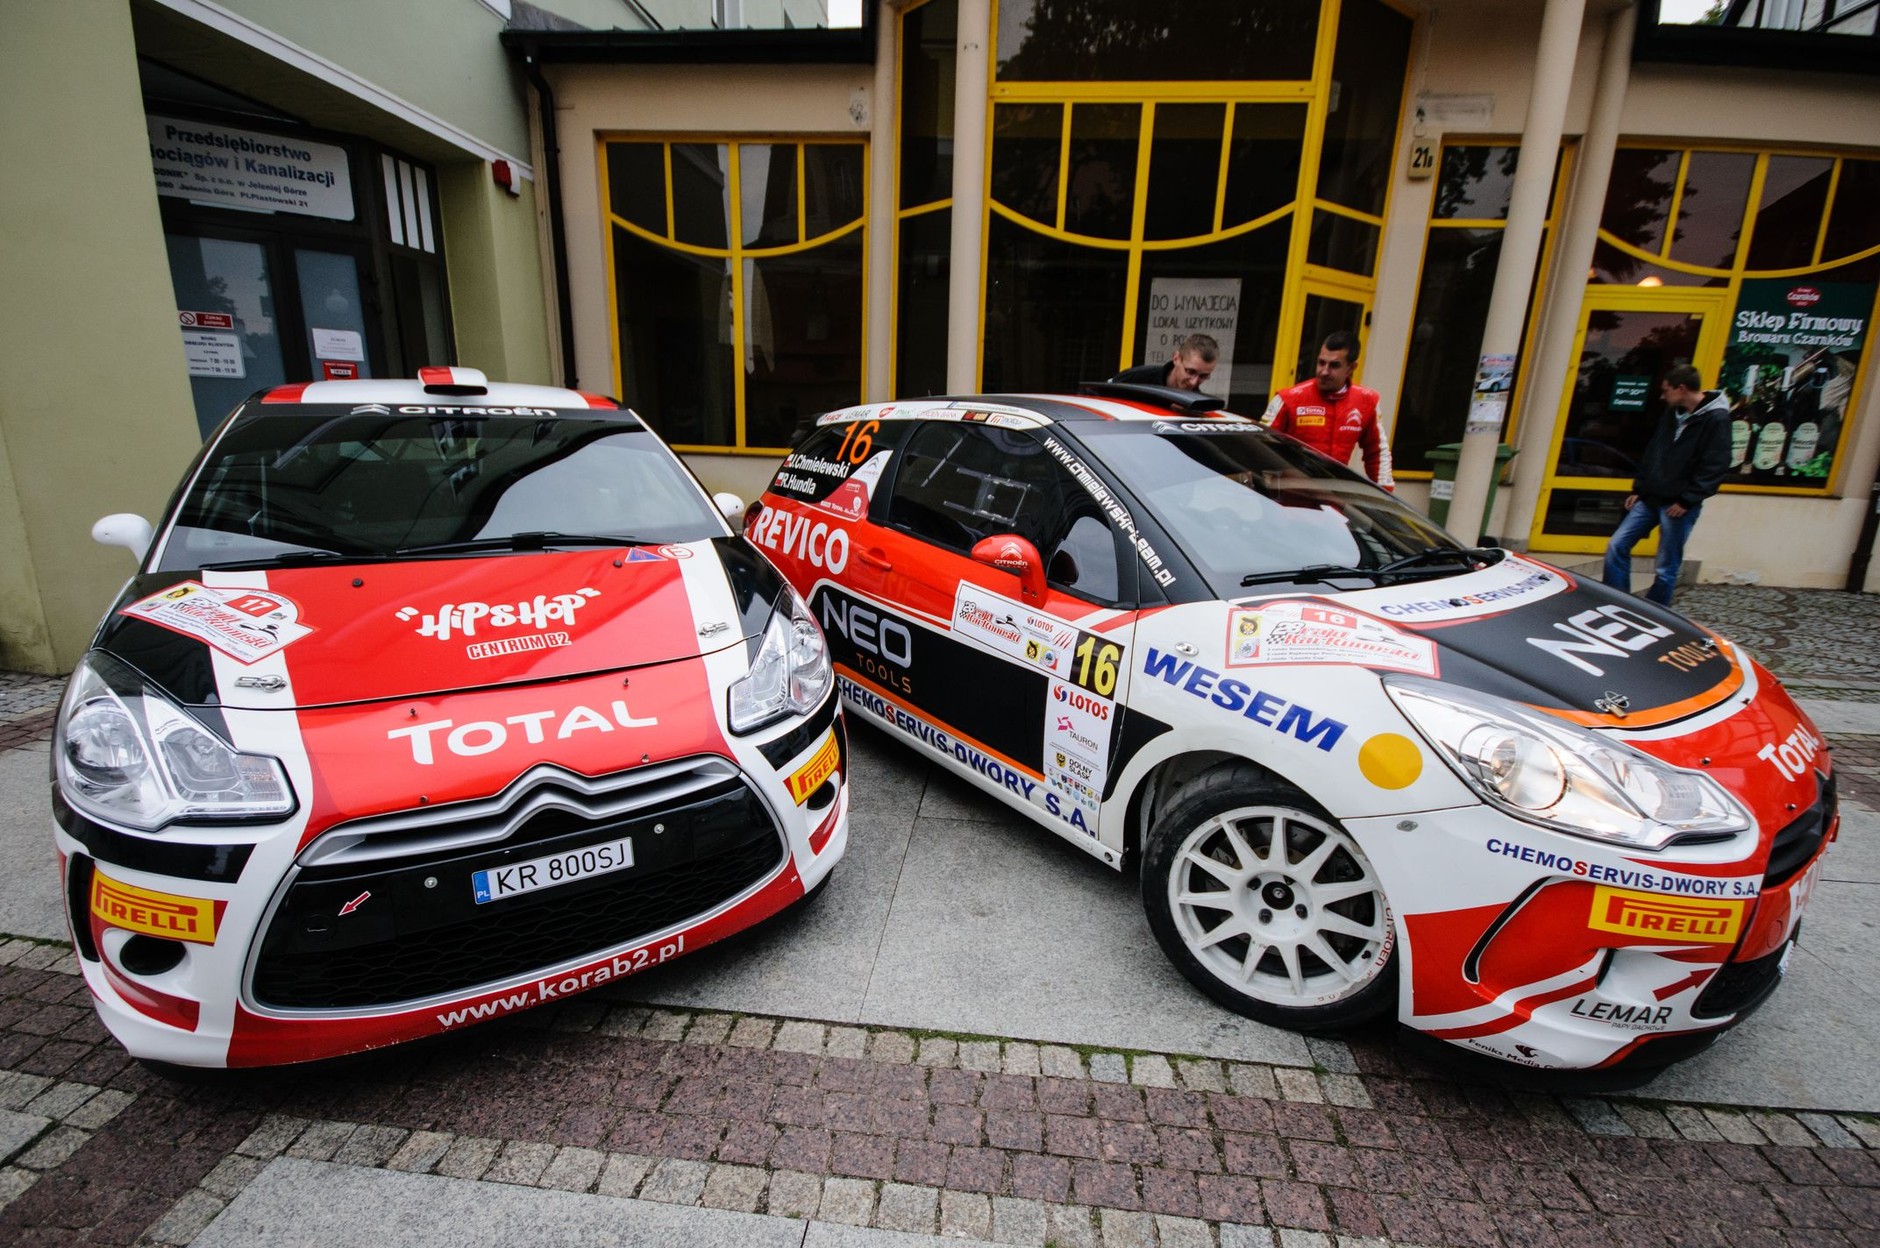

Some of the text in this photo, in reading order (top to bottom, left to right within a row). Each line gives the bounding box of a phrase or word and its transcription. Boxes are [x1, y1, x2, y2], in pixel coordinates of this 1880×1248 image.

[165, 125, 311, 162] Przedsiębiorstwo
[235, 156, 240, 170] i
[245, 159, 335, 188] Kanalizacji
[247, 181, 281, 193] Jeleniej
[283, 186, 307, 196] Górze
[1151, 294, 1169, 310] DO
[1153, 316, 1181, 329] LOKAL
[1735, 310, 1863, 335] Sklep Firmowy
[1737, 330, 1855, 347] Browaru Czarnków
[835, 420, 880, 465] 16
[789, 454, 850, 479] J.Chmielewski
[781, 472, 817, 495] R.Hundla
[752, 506, 850, 575] REVICO
[240, 598, 274, 611] 17
[1313, 611, 1346, 625] 16
[822, 591, 912, 669] NEO
[1034, 616, 1054, 633] LOTOS
[1526, 604, 1675, 677] NEO
[466, 631, 572, 660] CENTRUM B2
[855, 653, 912, 694] TOOLS
[1076, 635, 1119, 696] 16
[1069, 691, 1109, 721] LOTOS
[1143, 647, 1349, 753] WESEM
[387, 700, 659, 765] TOTAL
[1068, 730, 1099, 751] TAURON
[1756, 722, 1820, 783] TOTAL
[1045, 793, 1096, 838] S.A.
[497, 843, 625, 895] KR 800SJ
[1486, 838, 1728, 896] CHEMOSERVIS-DWORY
[1733, 881, 1760, 896] S.A.
[96, 881, 198, 933] PIRELLI
[477, 890, 490, 899] PL
[1605, 895, 1732, 935] PIRELLI
[437, 935, 684, 1028] www.korab2.pl
[1571, 999, 1673, 1024] LEMAR
[1468, 1038, 1540, 1069] Feniks Media
